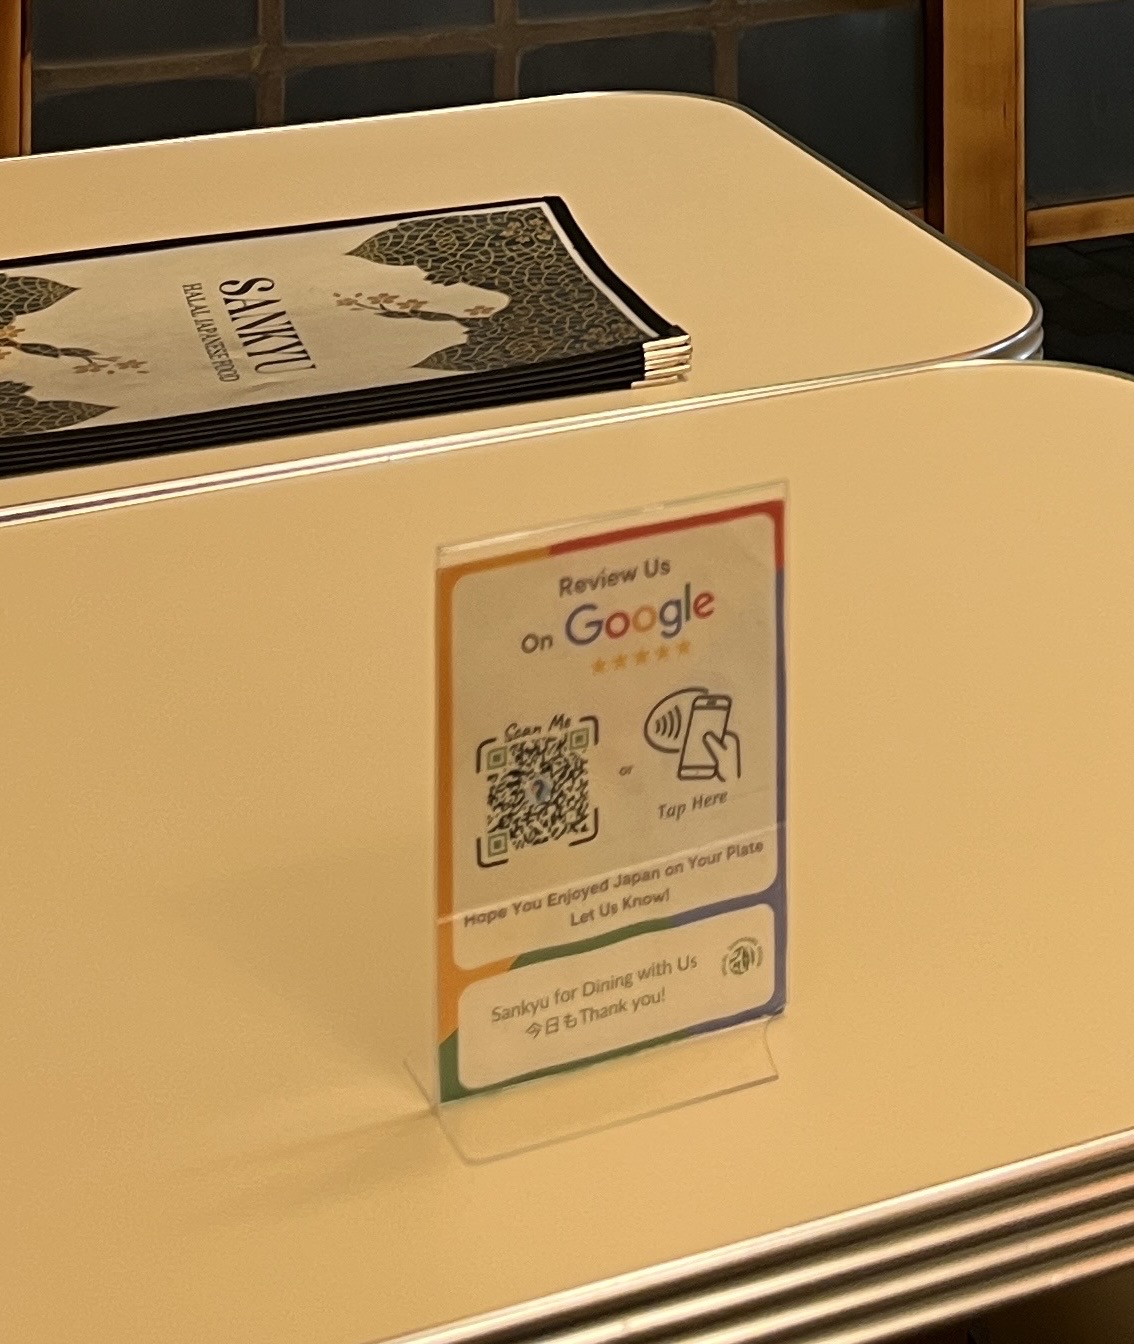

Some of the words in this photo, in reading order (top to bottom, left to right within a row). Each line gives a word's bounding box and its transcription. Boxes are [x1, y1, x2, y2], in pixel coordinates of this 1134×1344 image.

[182, 282, 211, 318] HALAL
[219, 277, 316, 374] SANKYU
[558, 565, 638, 598] Review
[643, 555, 671, 578] Us
[520, 632, 554, 654] On
[565, 582, 715, 646] Google
[504, 723, 542, 743] Scan
[549, 713, 572, 732] Me
[618, 764, 634, 777] or
[658, 802, 687, 822] Tap
[692, 791, 728, 811] Here
[464, 906, 508, 928] Hope
[512, 898, 542, 916] You
[547, 878, 609, 907] Enjoyed
[613, 869, 661, 889] Japan
[664, 862, 684, 877] on
[688, 851, 722, 870] Your
[726, 841, 764, 861] Plate
[570, 910, 595, 927] Let
[599, 902, 618, 917] Us
[622, 888, 671, 911] Know!
[491, 993, 550, 1024] Sankyu
[554, 986, 578, 1005] for
[582, 972, 634, 998] Dining
[637, 959, 673, 981] with
[677, 955, 698, 972] Us
[579, 998, 629, 1023] Thank
[632, 987, 666, 1013] you!
